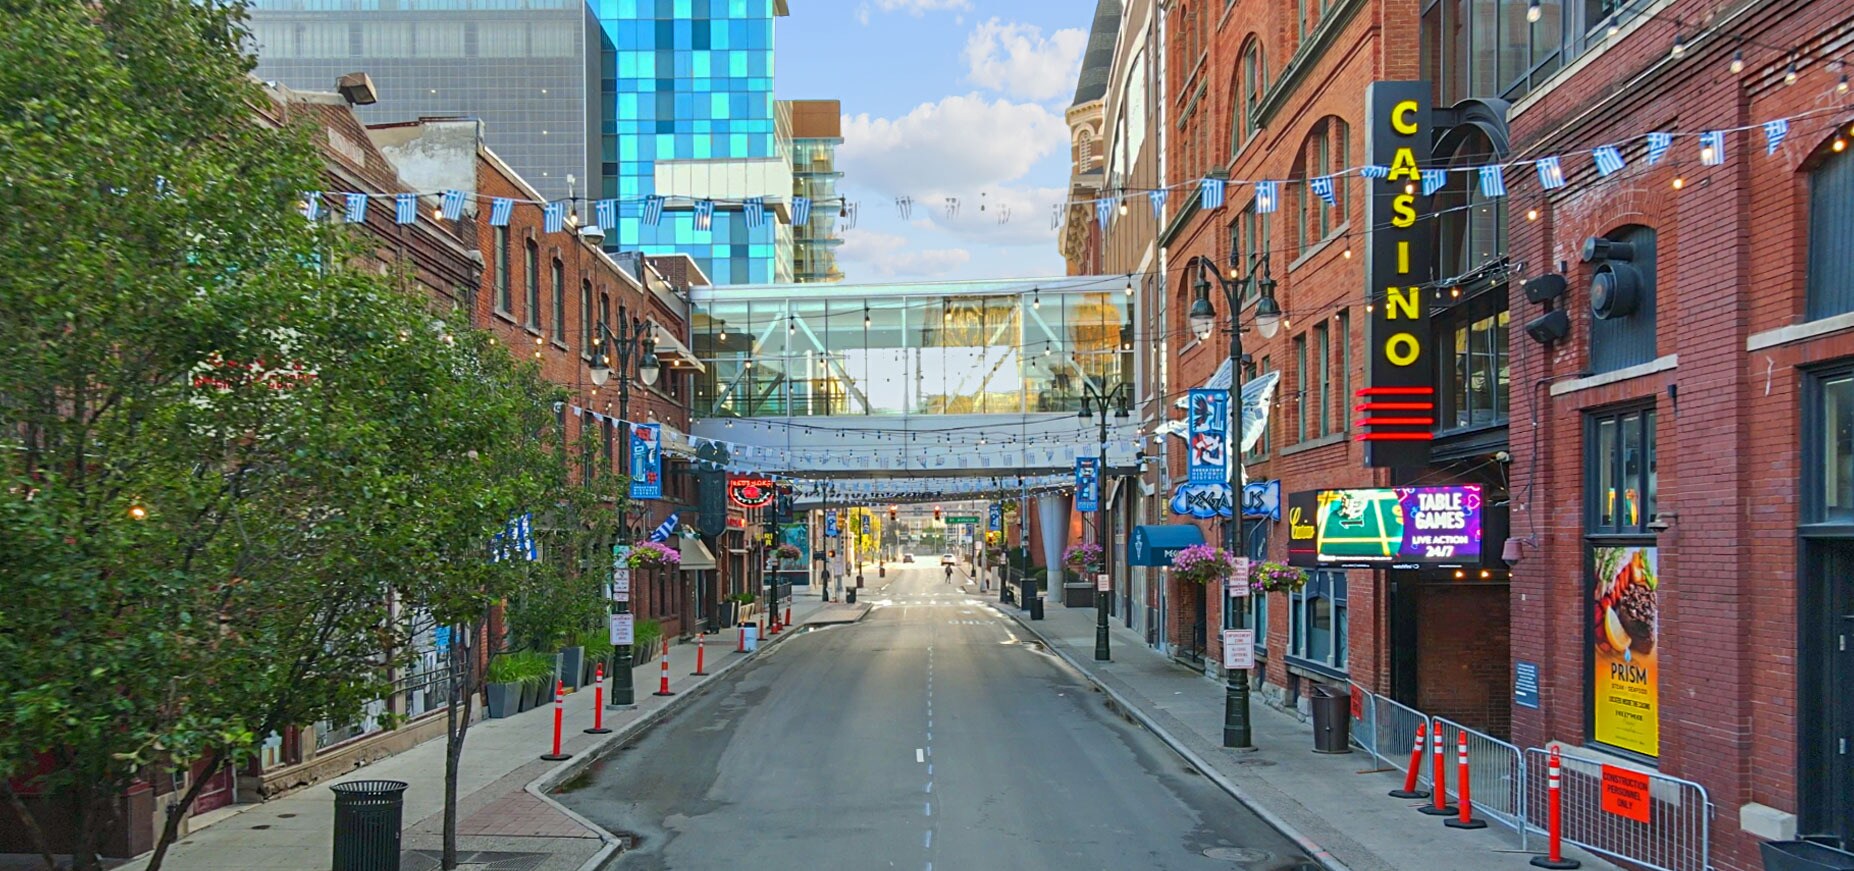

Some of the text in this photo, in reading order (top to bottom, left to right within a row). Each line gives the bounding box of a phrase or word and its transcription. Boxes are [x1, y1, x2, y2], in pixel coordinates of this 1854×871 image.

[1385, 100, 1421, 367] CASINO
[1186, 490, 1265, 511] PEGAUS
[1418, 493, 1462, 511] TABLE
[1415, 511, 1465, 530] GAMES
[1412, 535, 1469, 545] LIVE ACTION
[1425, 545, 1454, 558] 24/7
[1611, 662, 1647, 685] PRISM
[1602, 772, 1649, 791] CONSTRUCTION
[1607, 784, 1641, 801] PERSONNEL
[1617, 798, 1633, 810] ONLY
